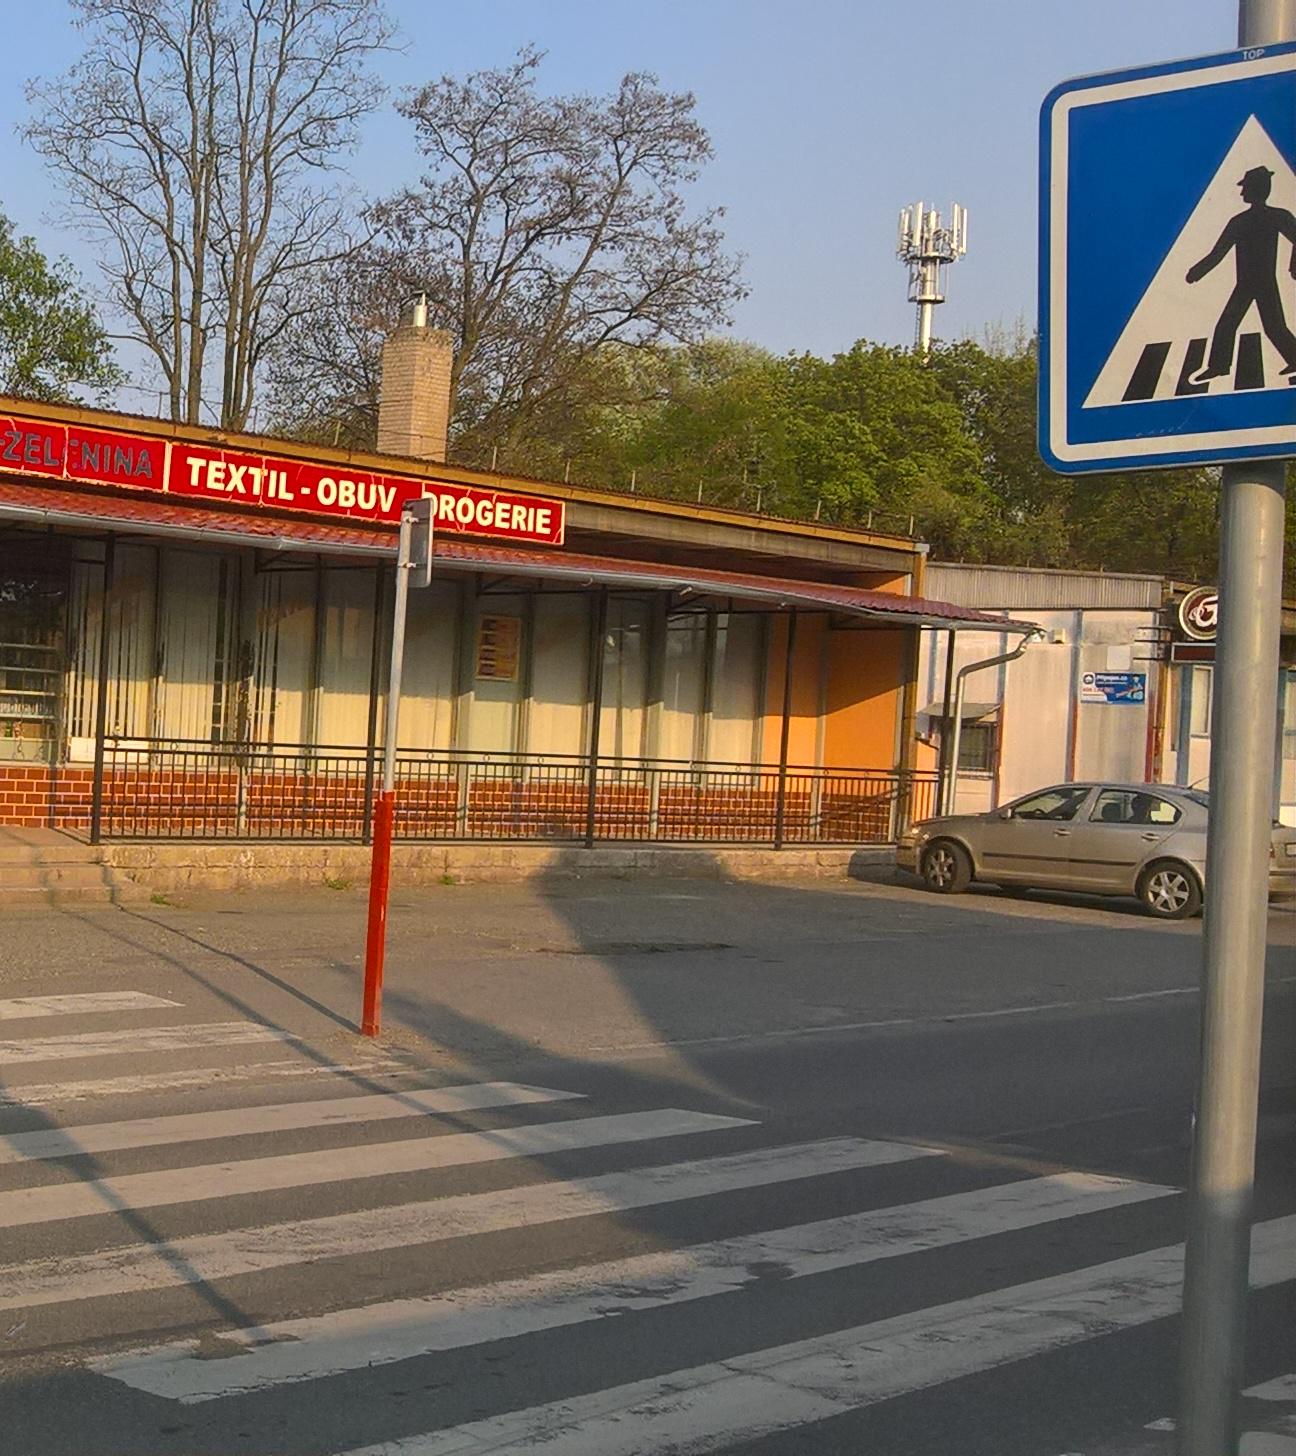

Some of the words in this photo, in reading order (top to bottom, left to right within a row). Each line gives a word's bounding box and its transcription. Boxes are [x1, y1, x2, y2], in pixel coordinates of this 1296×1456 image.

[1243, 48, 1265, 60] TOP
[186, 456, 294, 501] TEXTIL
[316, 476, 397, 513] OBUV
